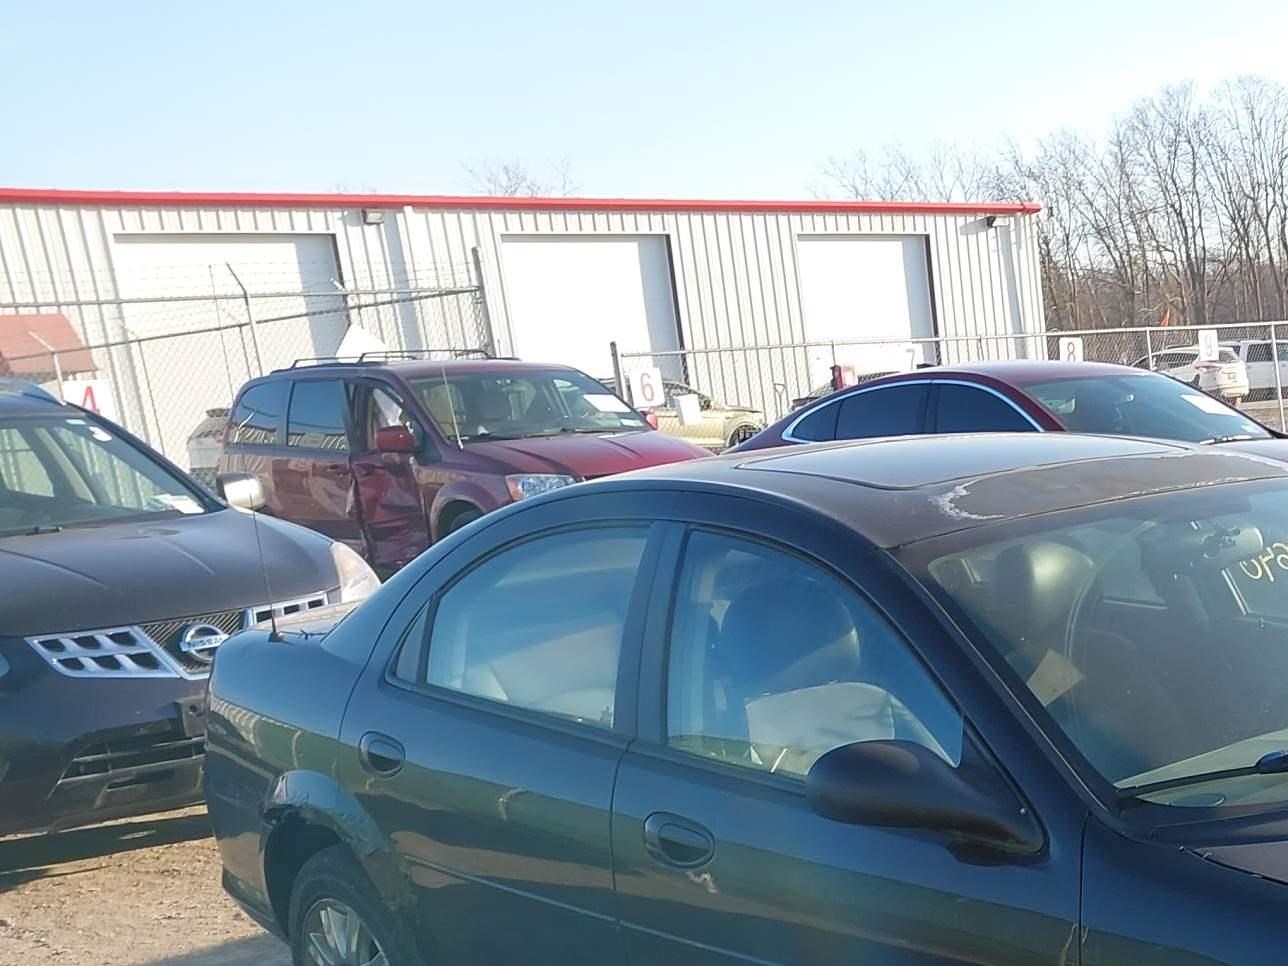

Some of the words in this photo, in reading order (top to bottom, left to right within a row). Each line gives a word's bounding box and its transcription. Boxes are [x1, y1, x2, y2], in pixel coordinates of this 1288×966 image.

[1067, 342, 1076, 362] 8
[1204, 334, 1212, 357] 9
[640, 372, 655, 402] 6
